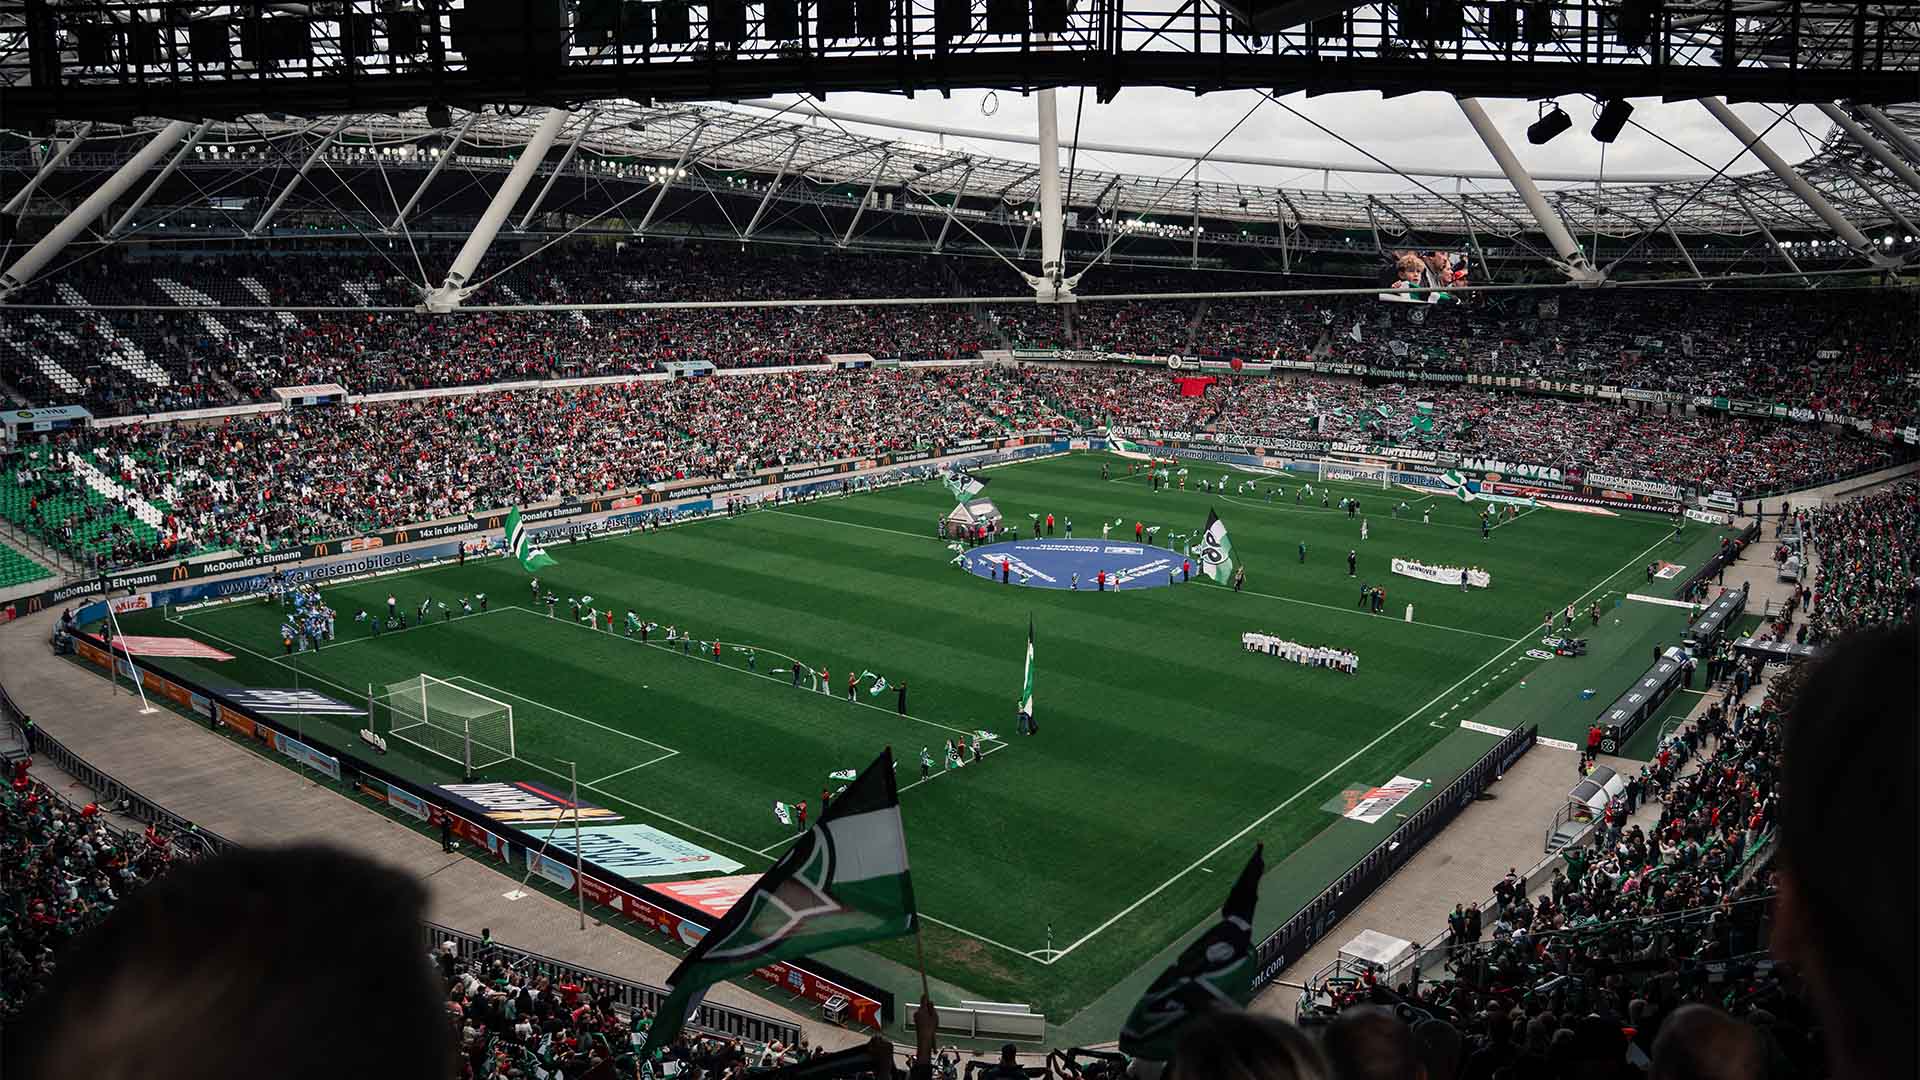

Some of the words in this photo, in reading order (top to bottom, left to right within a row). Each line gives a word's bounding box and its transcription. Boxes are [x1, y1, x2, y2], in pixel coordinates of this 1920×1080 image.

[521, 510, 552, 523] Donald's
[553, 506, 582, 517] Ehmann
[419, 528, 433, 539] 14x
[434, 528, 441, 536] in
[441, 525, 456, 535] der
[457, 522, 478, 533] Nähe
[203, 556, 261, 575] McDonald's
[262, 550, 302, 565] Ehmann
[1406, 565, 1437, 577] HANNOVER
[112, 573, 157, 590] Ehmann
